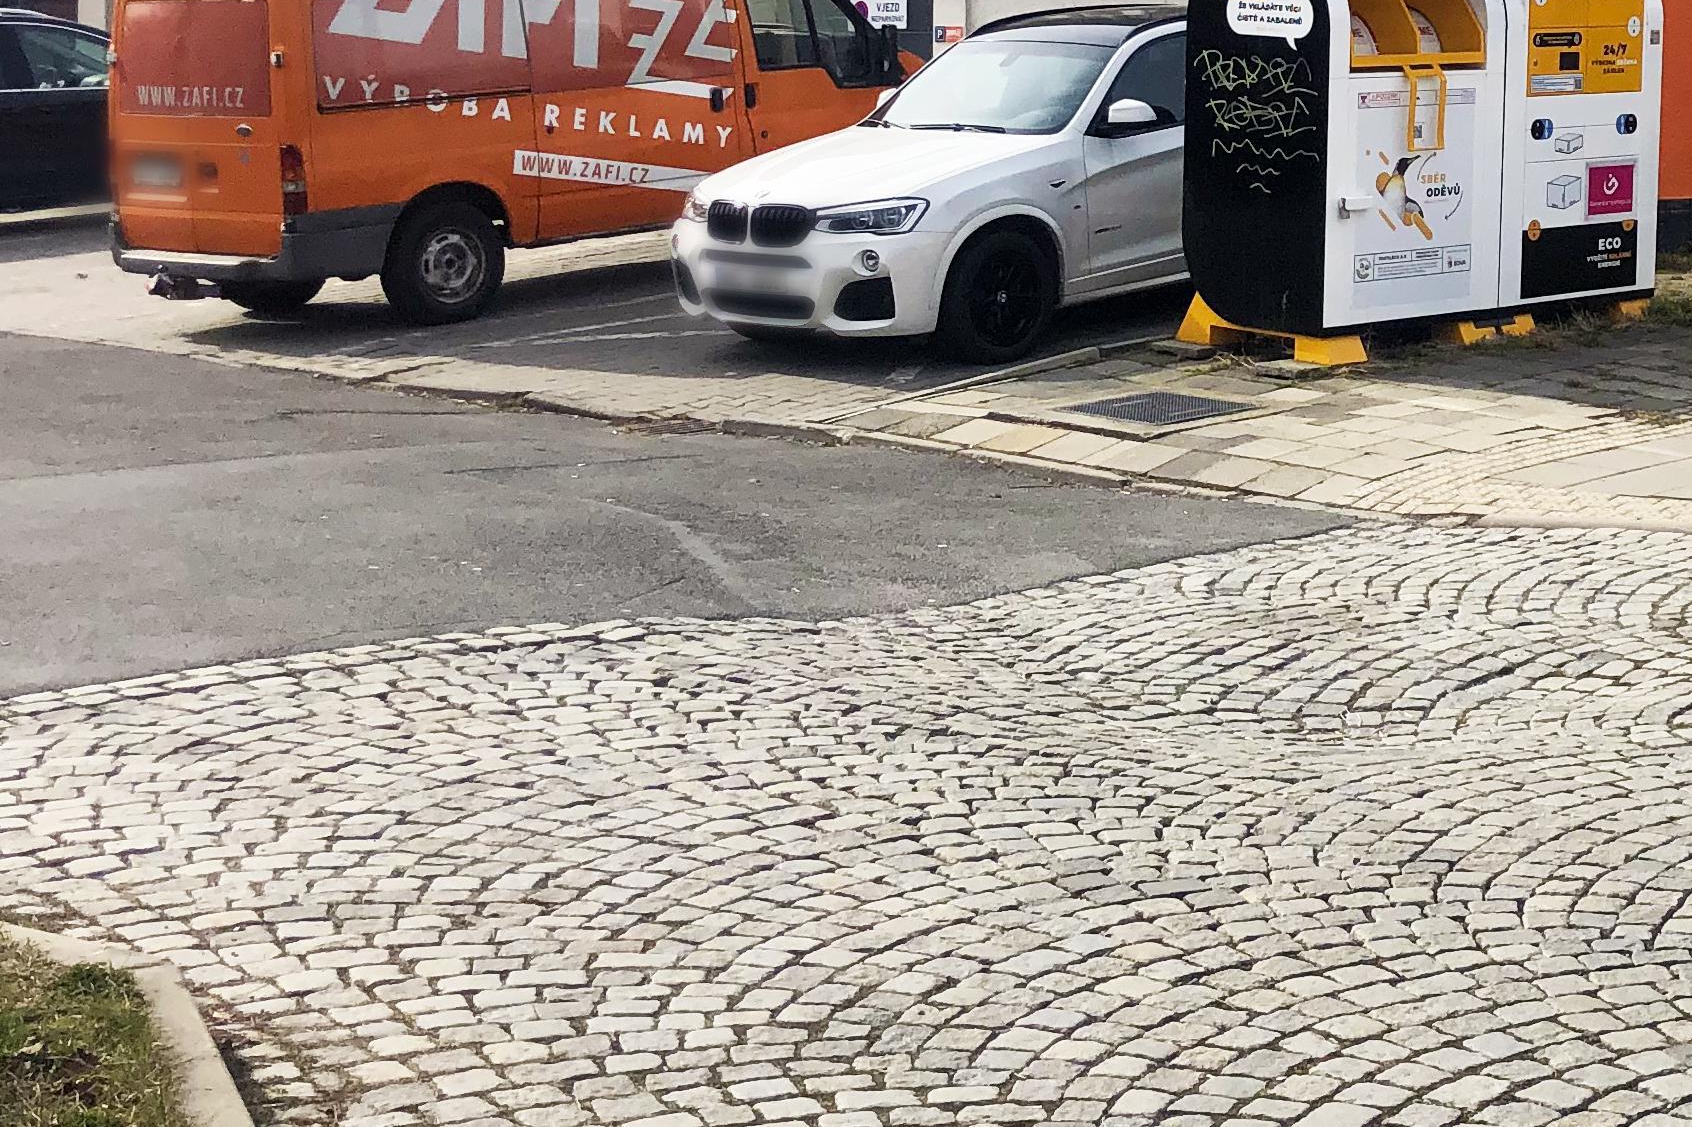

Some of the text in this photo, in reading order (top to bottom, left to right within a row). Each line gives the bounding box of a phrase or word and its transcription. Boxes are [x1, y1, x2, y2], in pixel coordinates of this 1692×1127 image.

[876, 2, 900, 13] VJEZD
[937, 29, 944, 39] P
[1603, 43, 1627, 57] 24/7
[137, 85, 245, 108] WWW.ZAFI.CZ
[322, 74, 735, 148] VÝROBA REKLAMY
[520, 154, 650, 185] WWW.ZAFI.CZ
[1421, 172, 1446, 184] SBĚR
[1426, 183, 1460, 197] ODĚVŮ
[1598, 237, 1621, 251] ECO
